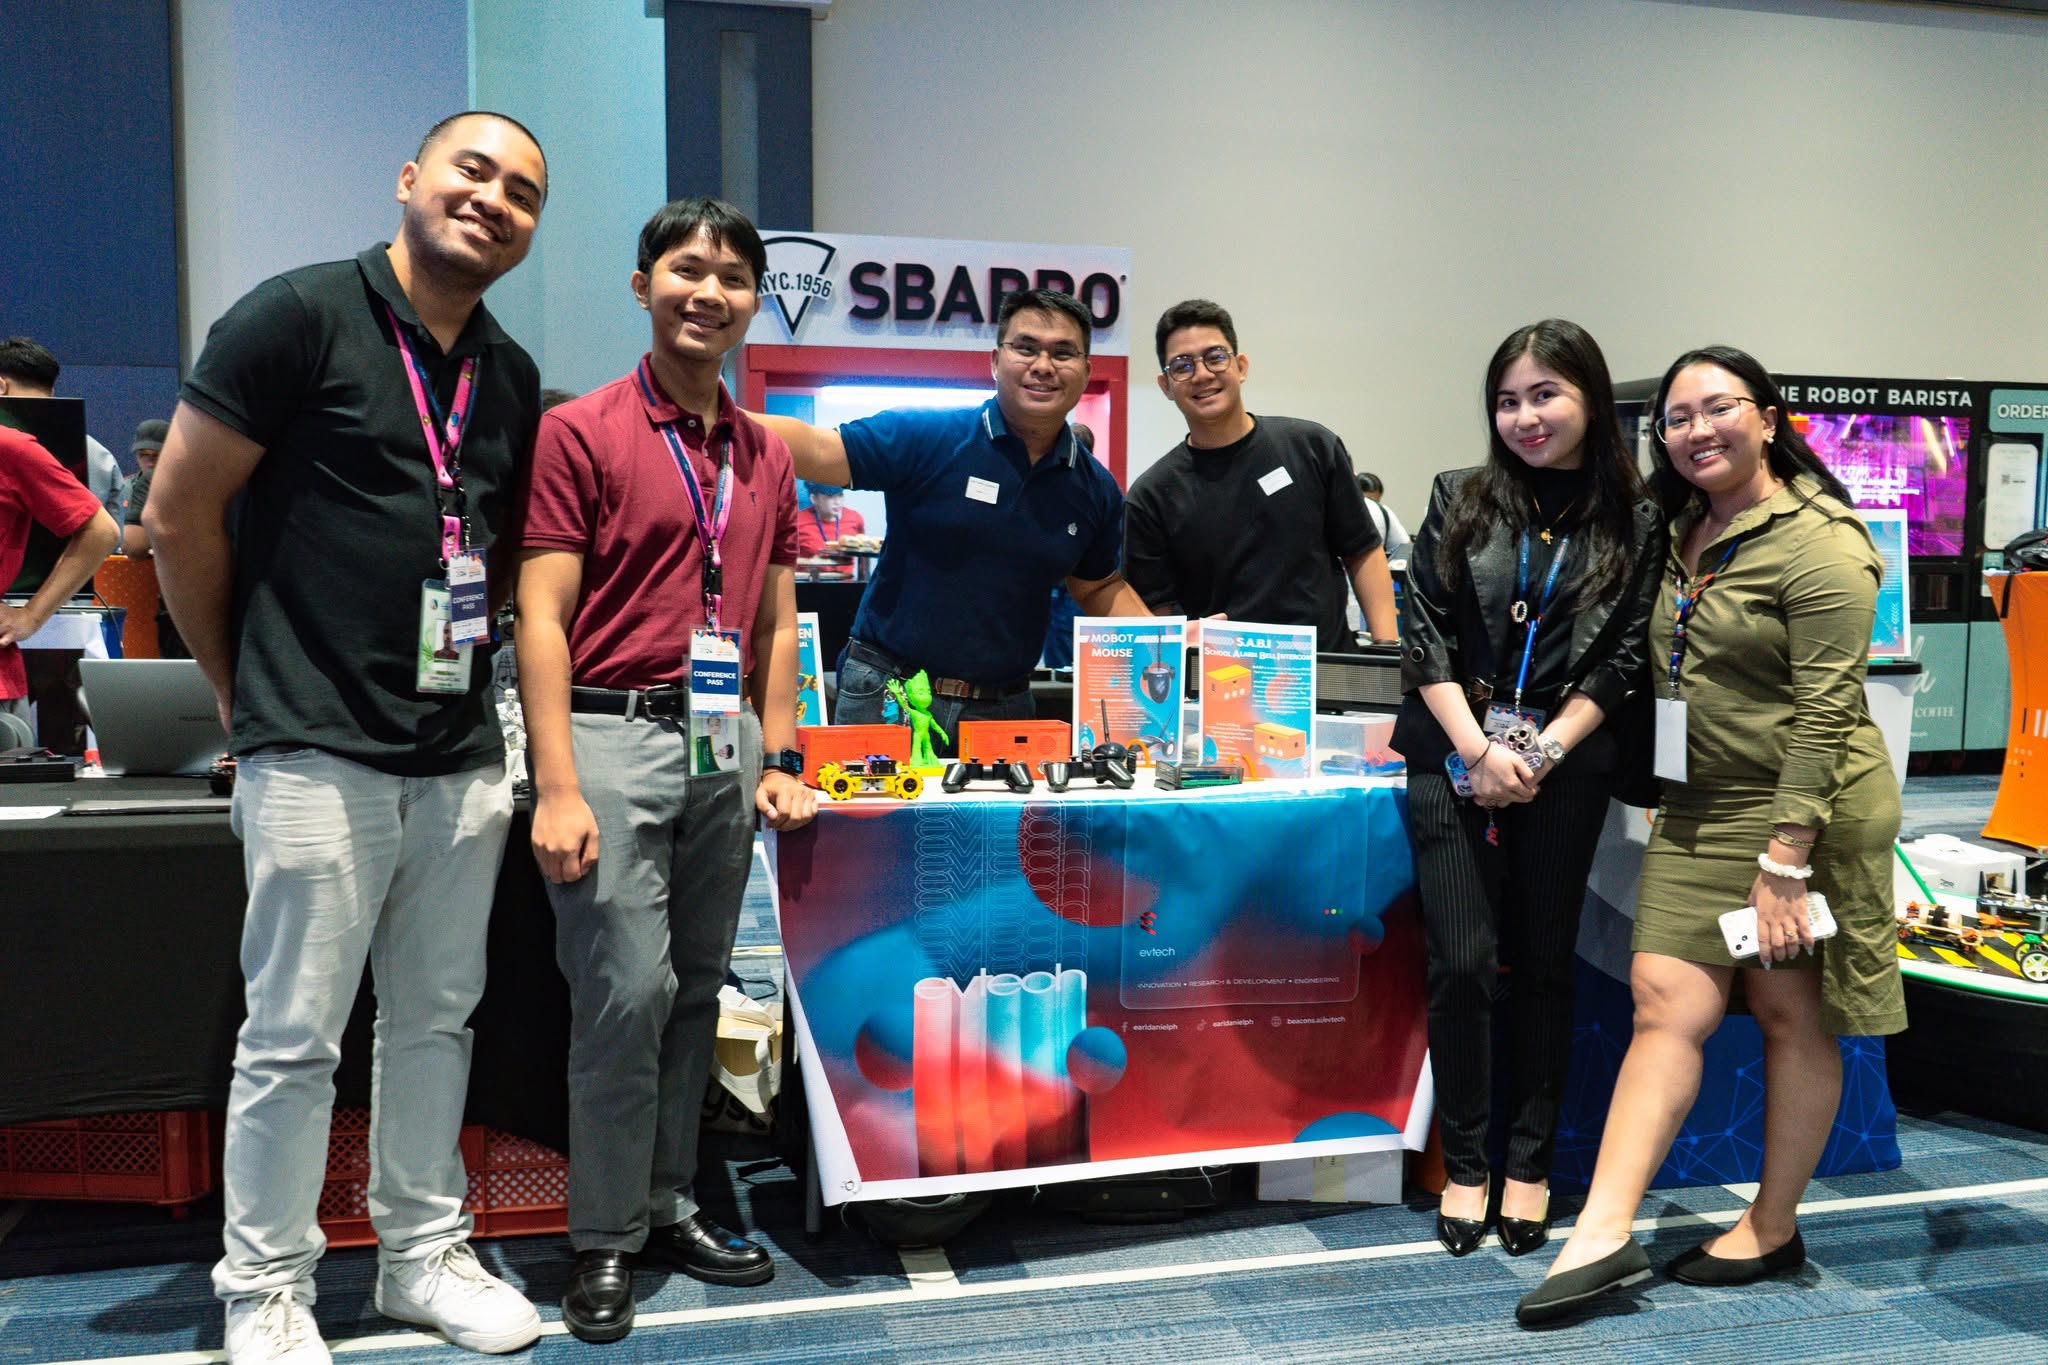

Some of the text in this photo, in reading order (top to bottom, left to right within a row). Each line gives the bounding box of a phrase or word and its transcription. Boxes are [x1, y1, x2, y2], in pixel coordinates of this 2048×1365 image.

[1807, 386, 1879, 405] ROBOT
[1887, 390, 1973, 408] BARISTA
[1091, 634, 1134, 643] MOBOT
[1091, 648, 1134, 658] MOUSE
[693, 671, 737, 679] CONFERENCE
[1139, 946, 1175, 957] evtech
[913, 963, 1087, 1000] evtech
[1138, 981, 1181, 989] INNOVATION
[1188, 979, 1225, 987] RESEARCH
[1233, 977, 1287, 986] DEVELOPMENT
[1294, 976, 1340, 984] ENGINEERING
